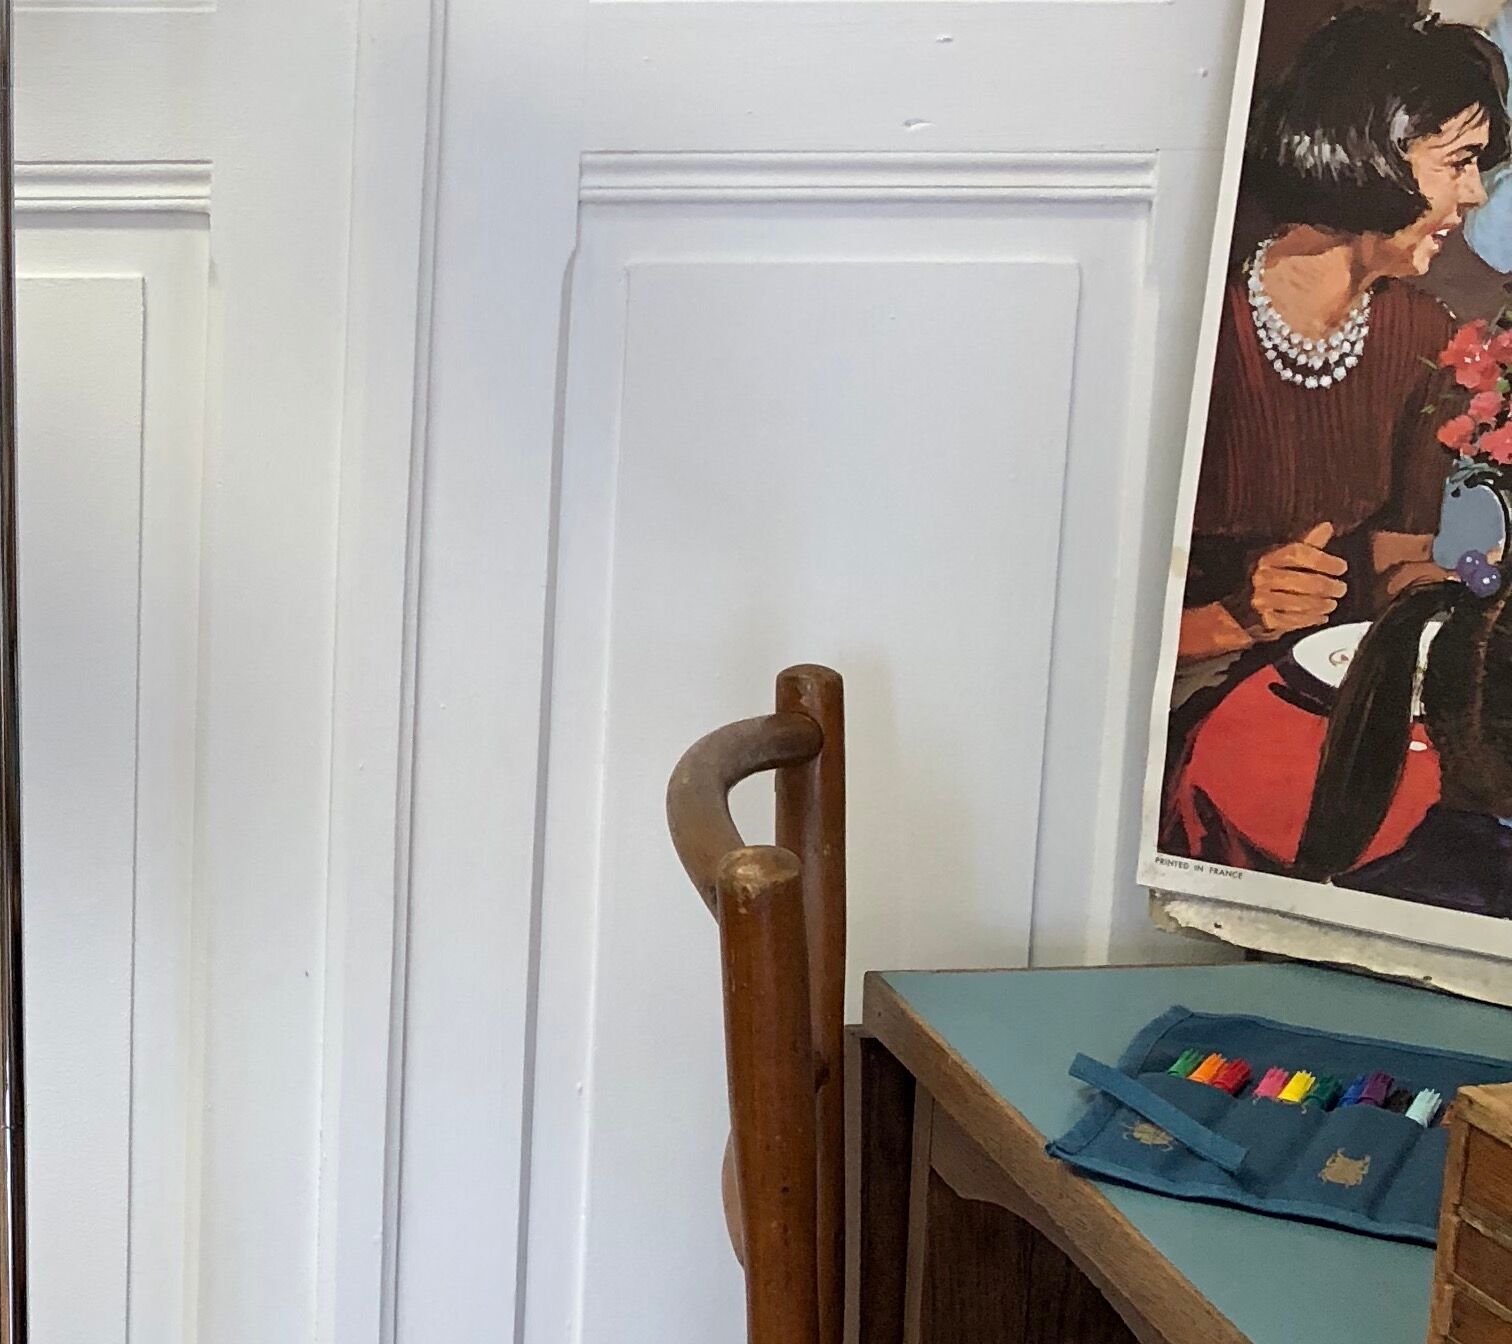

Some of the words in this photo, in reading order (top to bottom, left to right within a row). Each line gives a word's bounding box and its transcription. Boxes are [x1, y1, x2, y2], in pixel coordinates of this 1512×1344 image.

[1155, 856, 1190, 870] PRINTED
[1193, 863, 1204, 873] IN
[1209, 866, 1243, 880] FRANCE
